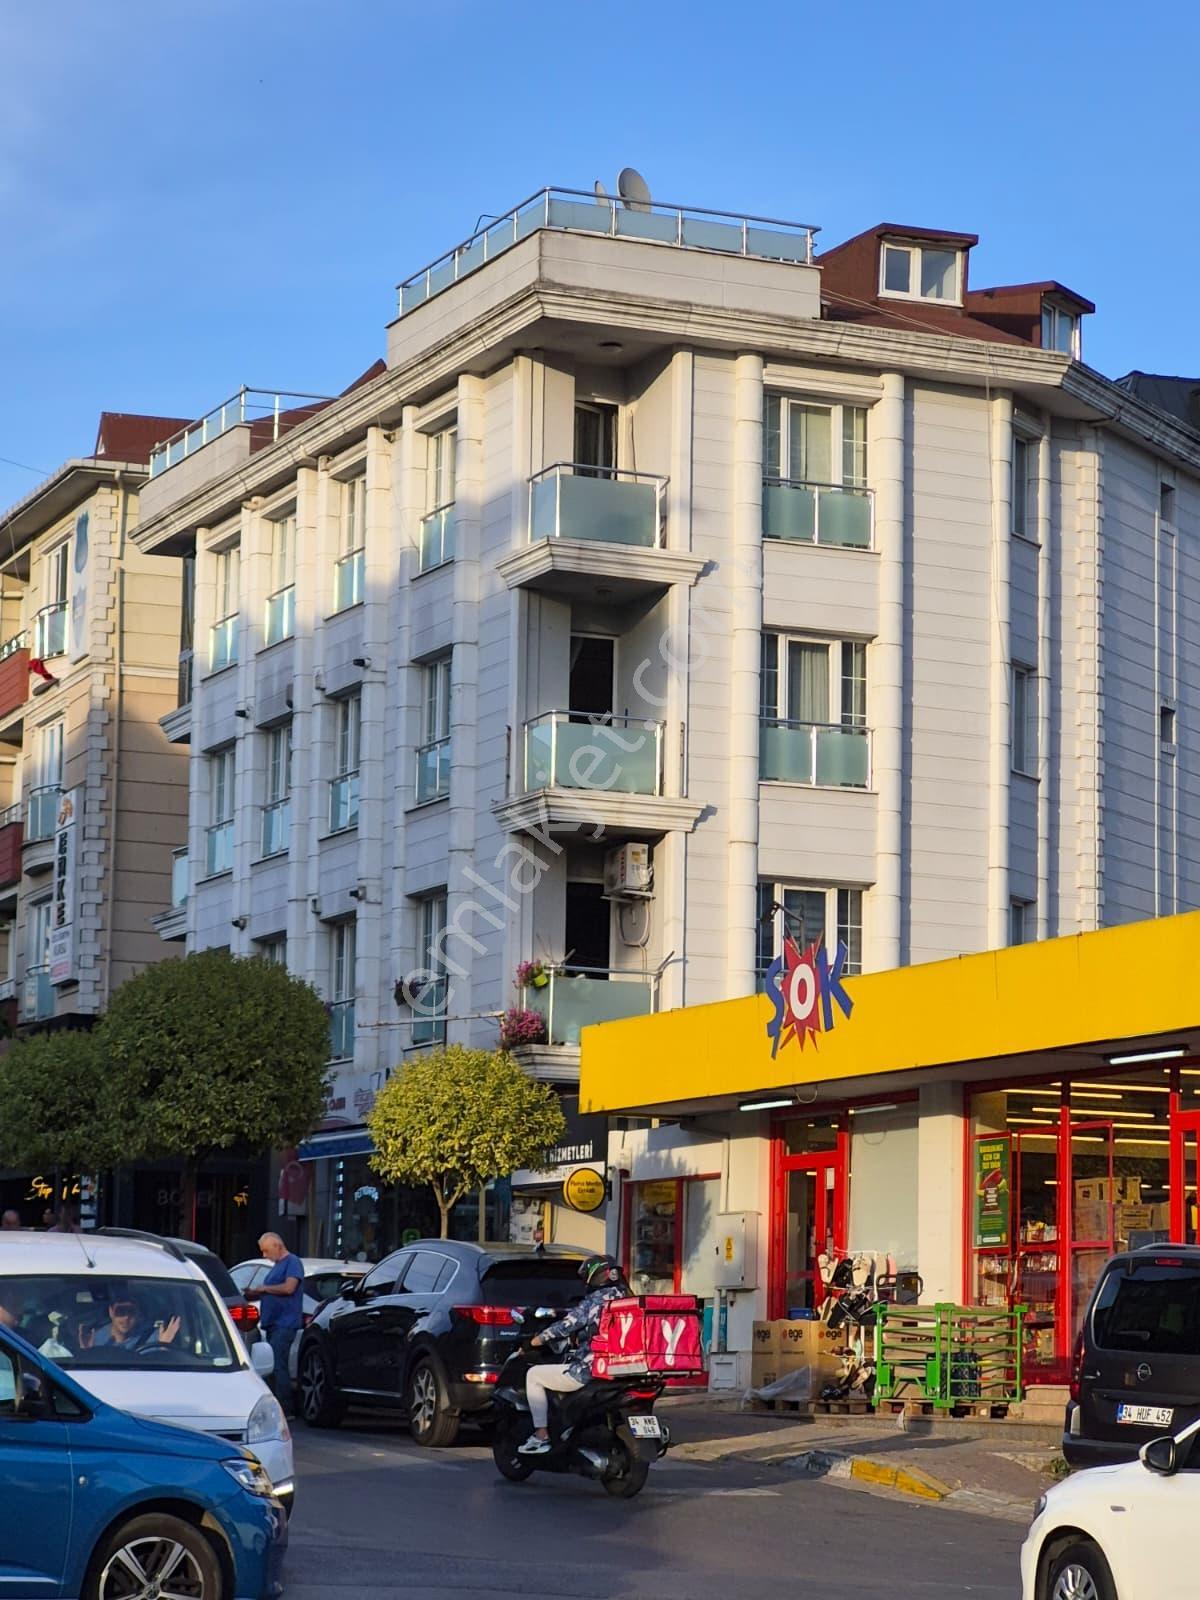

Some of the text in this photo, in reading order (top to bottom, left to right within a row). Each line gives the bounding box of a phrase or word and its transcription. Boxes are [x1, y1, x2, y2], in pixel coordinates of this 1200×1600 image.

[788, 1328, 803, 1342] ege
[1123, 1406, 1171, 1423] 34 HUF 452
